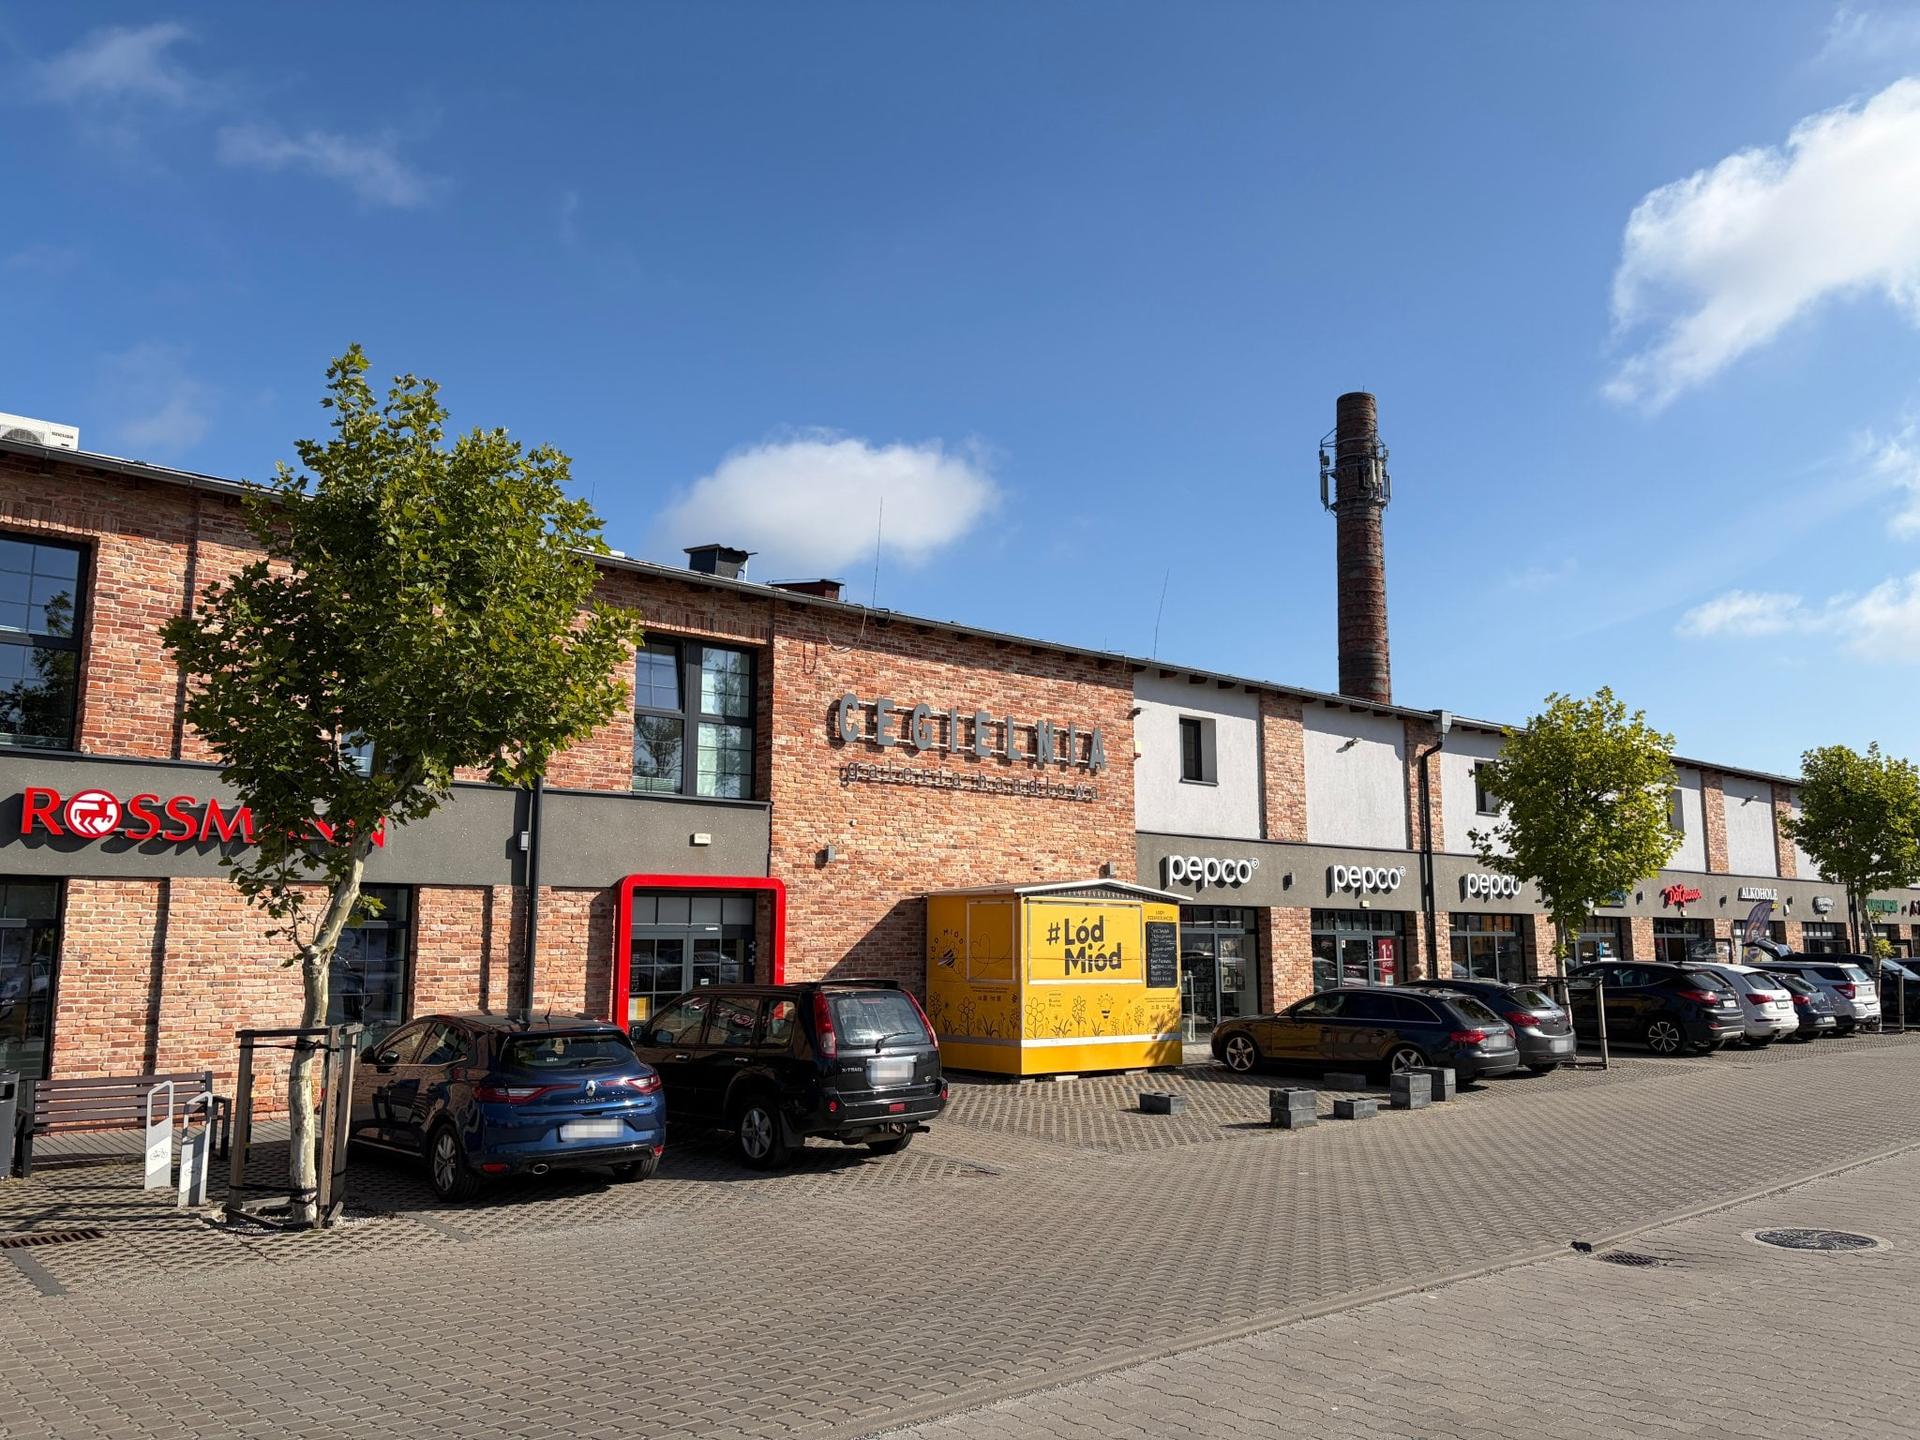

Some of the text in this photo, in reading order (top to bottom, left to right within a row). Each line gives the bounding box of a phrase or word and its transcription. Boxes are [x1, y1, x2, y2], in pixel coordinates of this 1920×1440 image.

[839, 692, 1107, 770] CEGIELNIA
[847, 761, 1099, 800] galeria handlowa
[20, 786, 386, 848] ROSSM
[1467, 873, 1522, 899] pepco
[1741, 887, 1778, 900] ALKOHOLE
[1065, 942, 1122, 976] Miód
